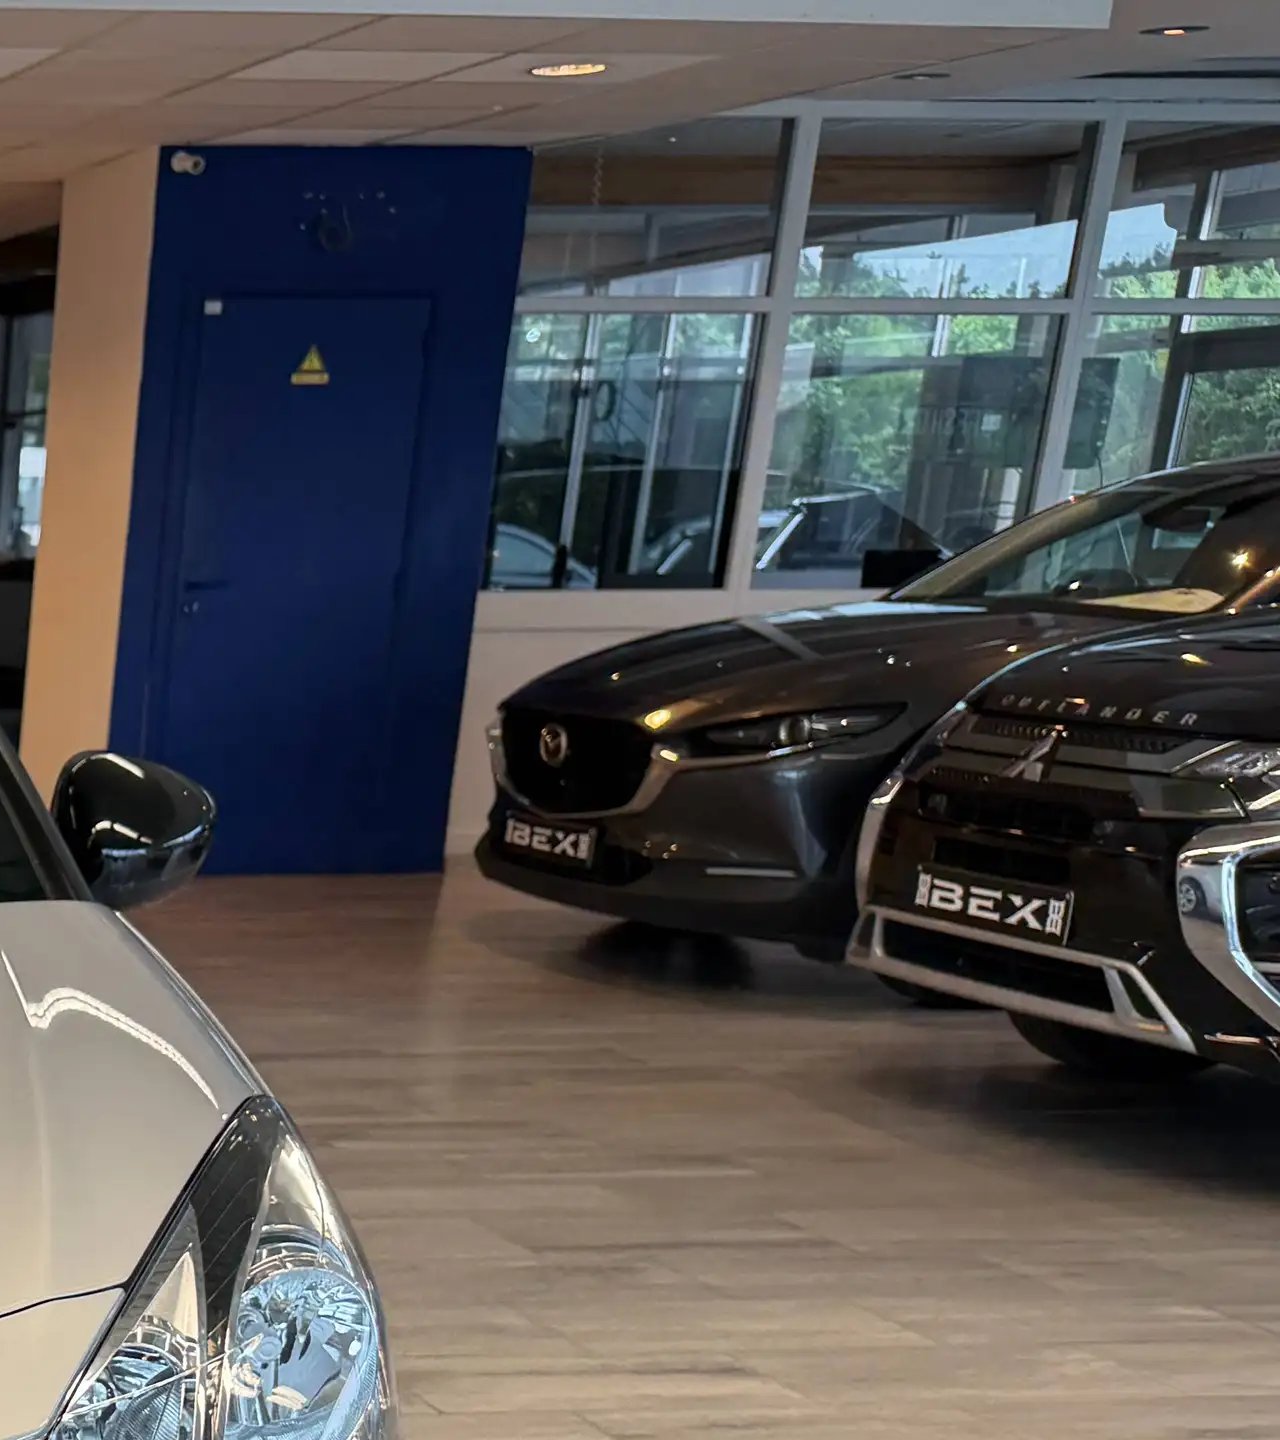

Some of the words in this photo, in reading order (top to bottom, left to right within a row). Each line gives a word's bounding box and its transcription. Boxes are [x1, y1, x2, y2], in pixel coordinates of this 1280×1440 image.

[1000, 694, 1199, 726] OUTLANDER
[512, 820, 578, 858] BEX
[928, 877, 1048, 931] BEX
